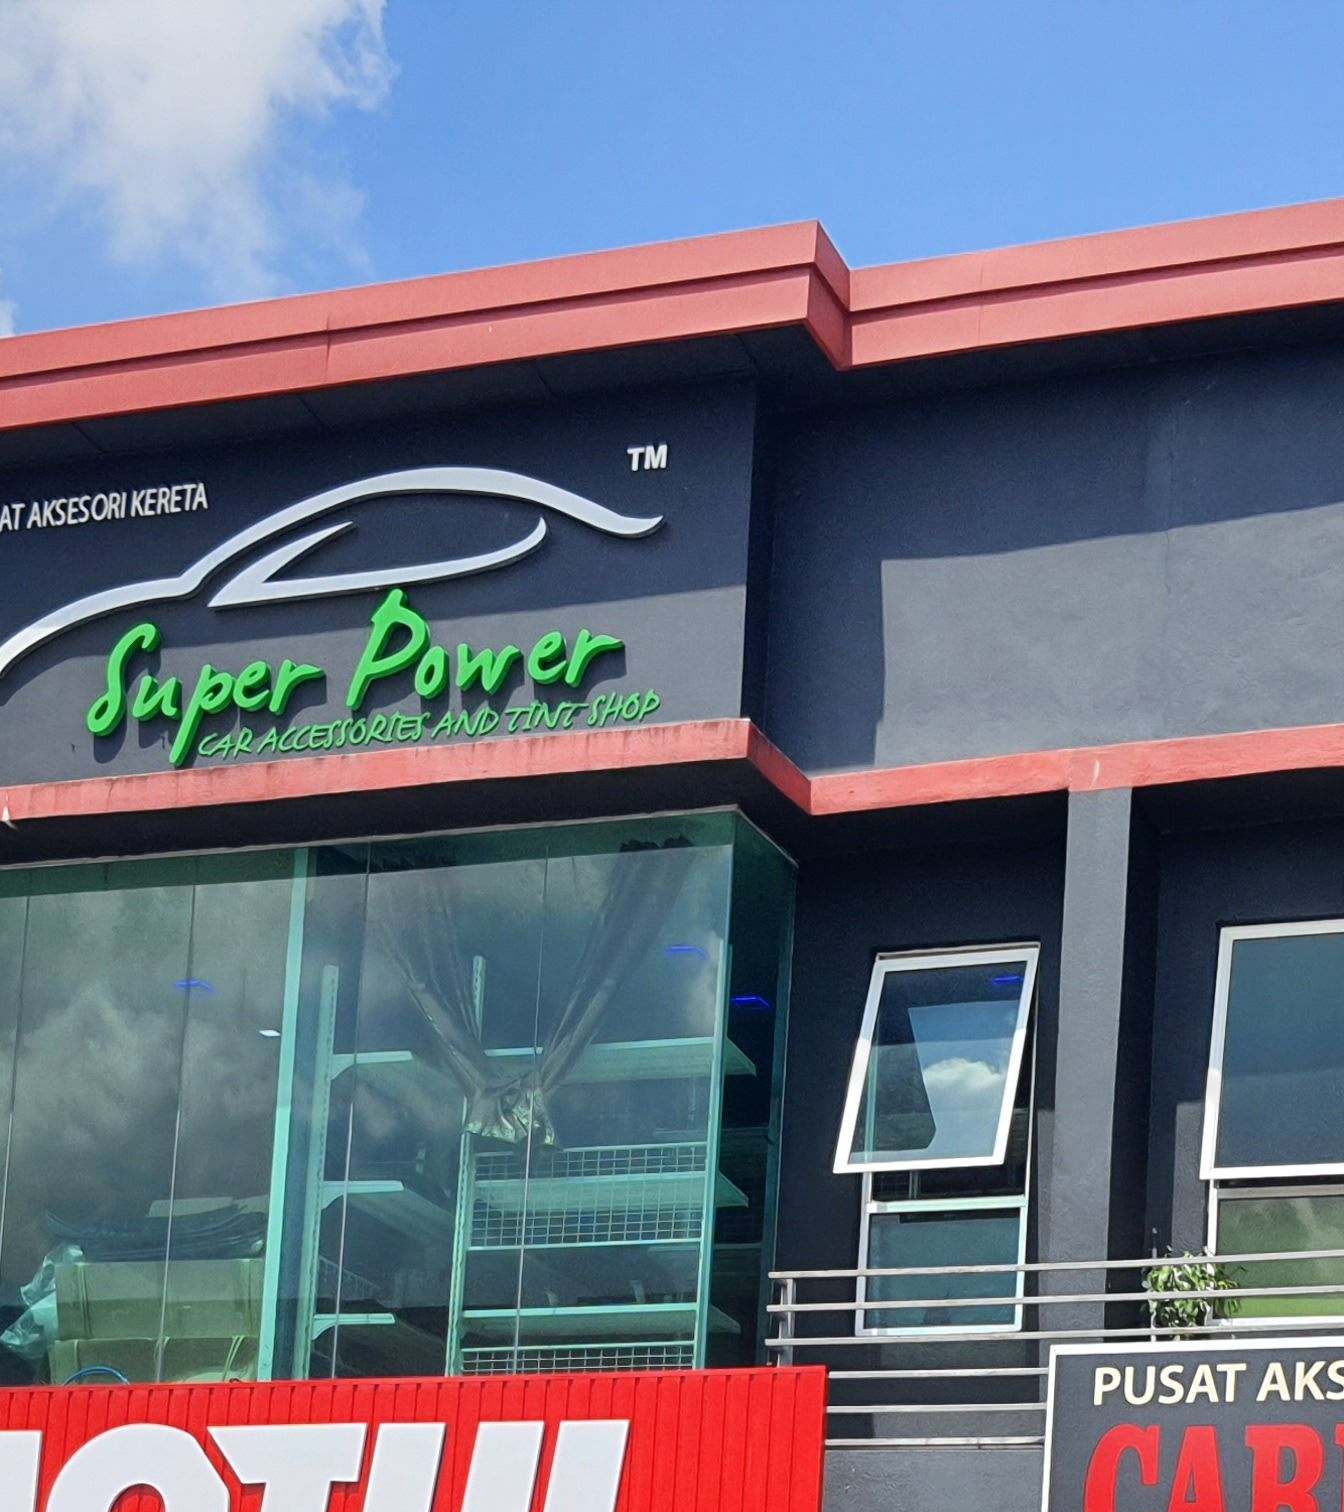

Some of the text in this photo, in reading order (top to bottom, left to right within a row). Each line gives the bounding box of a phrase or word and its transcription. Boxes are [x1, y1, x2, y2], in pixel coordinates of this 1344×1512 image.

[628, 445, 668, 472] TM
[26, 492, 127, 529] AKSESORI
[130, 482, 208, 517] KERETA
[87, 587, 624, 766] Super Power
[197, 691, 661, 758] CAR ACCESSORIES AND TINT SHOP
[1092, 1362, 1248, 1406] PUSAT
